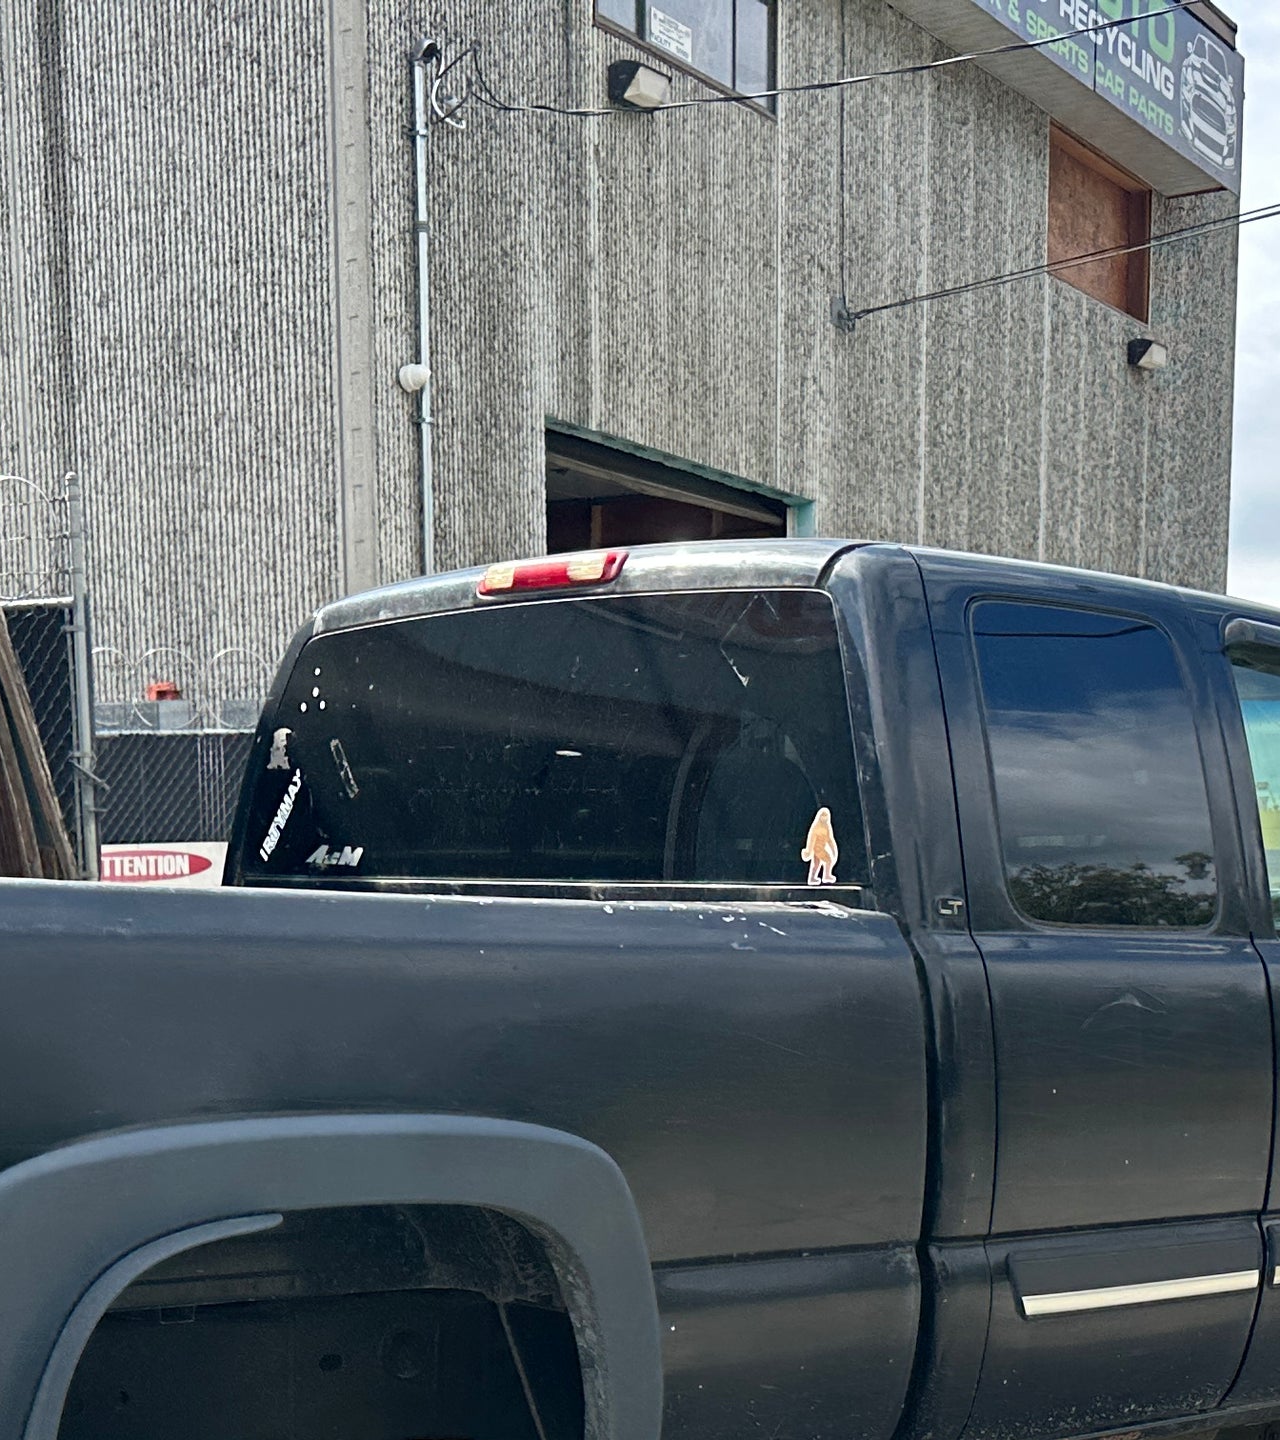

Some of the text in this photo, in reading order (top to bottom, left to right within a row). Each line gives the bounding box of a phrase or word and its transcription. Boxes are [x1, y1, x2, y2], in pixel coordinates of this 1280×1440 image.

[1026, 11, 1089, 74] SPORTS
[1096, 60, 1125, 100] CAR
[1129, 86, 1174, 136] PARTS
[1060, 0, 1175, 100] RECYCLING
[100, 854, 190, 877] TTENTION
[938, 900, 963, 915] LT
